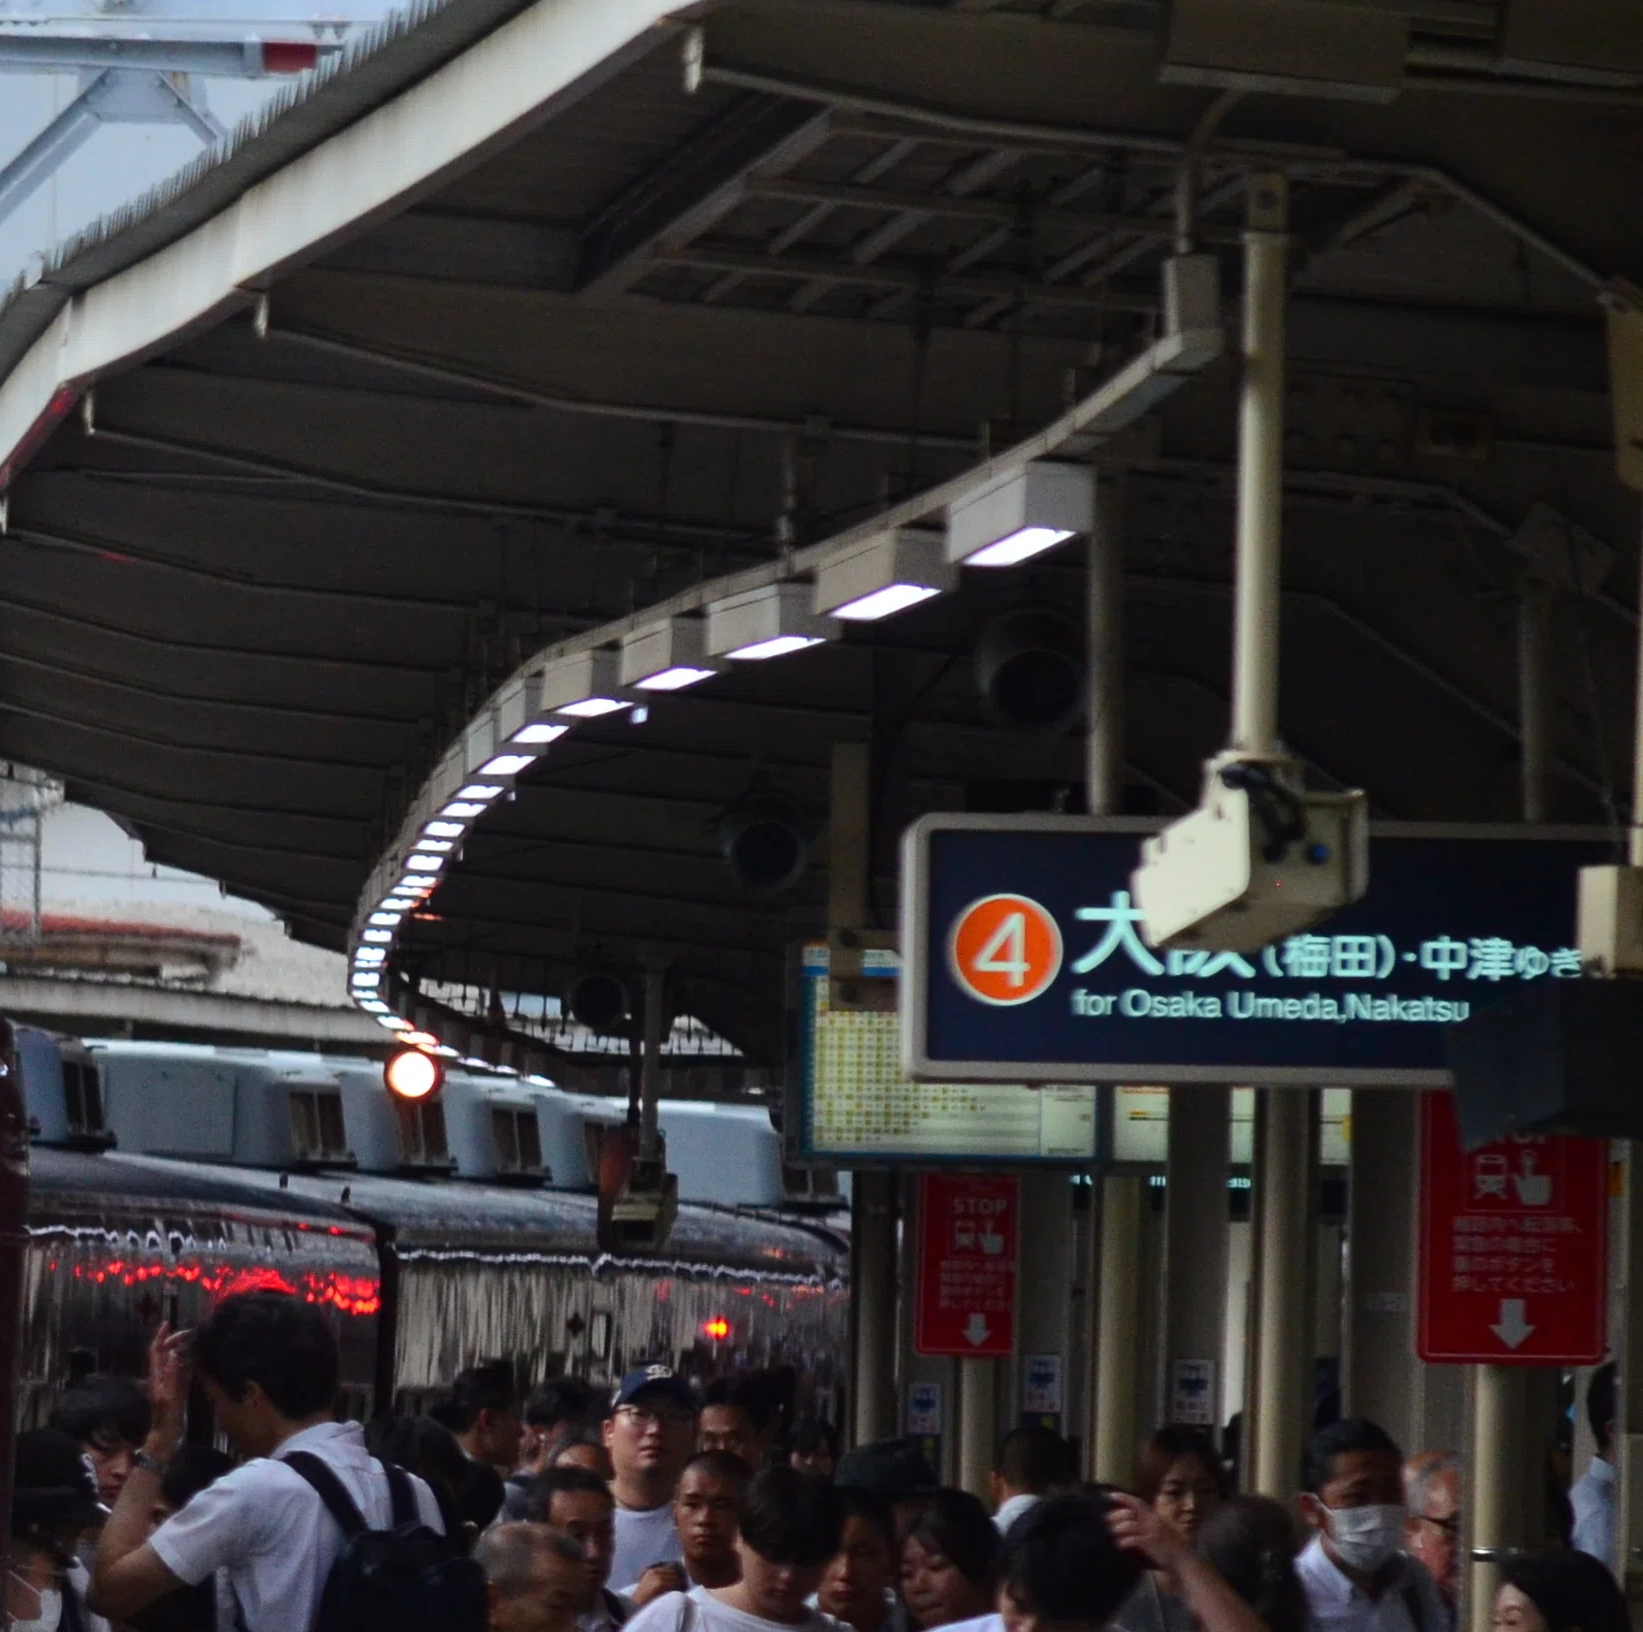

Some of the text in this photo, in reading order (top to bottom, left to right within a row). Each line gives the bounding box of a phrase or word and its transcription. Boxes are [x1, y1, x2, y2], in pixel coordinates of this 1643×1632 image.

[974, 911, 1032, 988] 4
[1071, 988, 1116, 1017] for
[1118, 988, 1223, 1018] Osaka
[953, 1198, 1007, 1216] STOP
